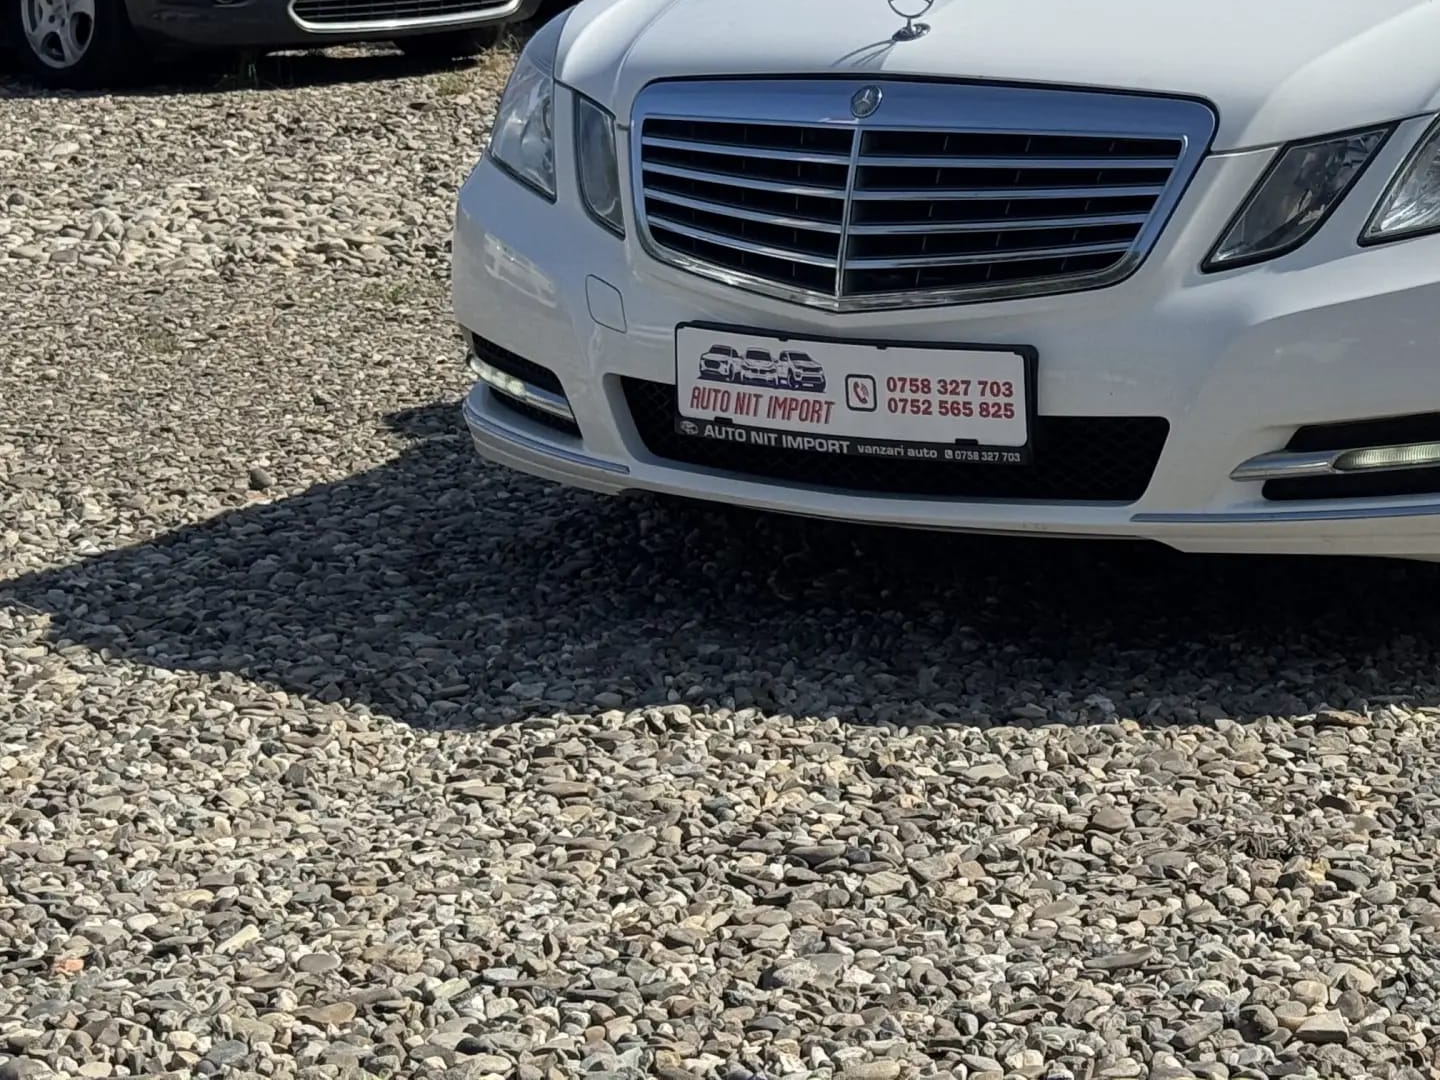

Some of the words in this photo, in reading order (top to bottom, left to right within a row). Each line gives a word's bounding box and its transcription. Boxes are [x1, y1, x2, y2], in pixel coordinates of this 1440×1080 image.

[886, 376, 932, 395] 0758
[937, 379, 972, 397] 327
[977, 381, 1014, 398] 703
[690, 386, 731, 413] AUTO
[734, 392, 763, 418] NIT
[767, 396, 835, 425] IMPORT
[887, 398, 933, 417] 0752
[938, 400, 974, 418] 565
[979, 402, 1015, 420] 825
[704, 424, 746, 442] AUTO
[750, 431, 777, 447] NIT
[782, 435, 850, 454] IMPORT
[857, 444, 904, 456] vanzari
[907, 447, 938, 458] auto
[981, 451, 999, 461] 327
[1003, 452, 1021, 462] 703
